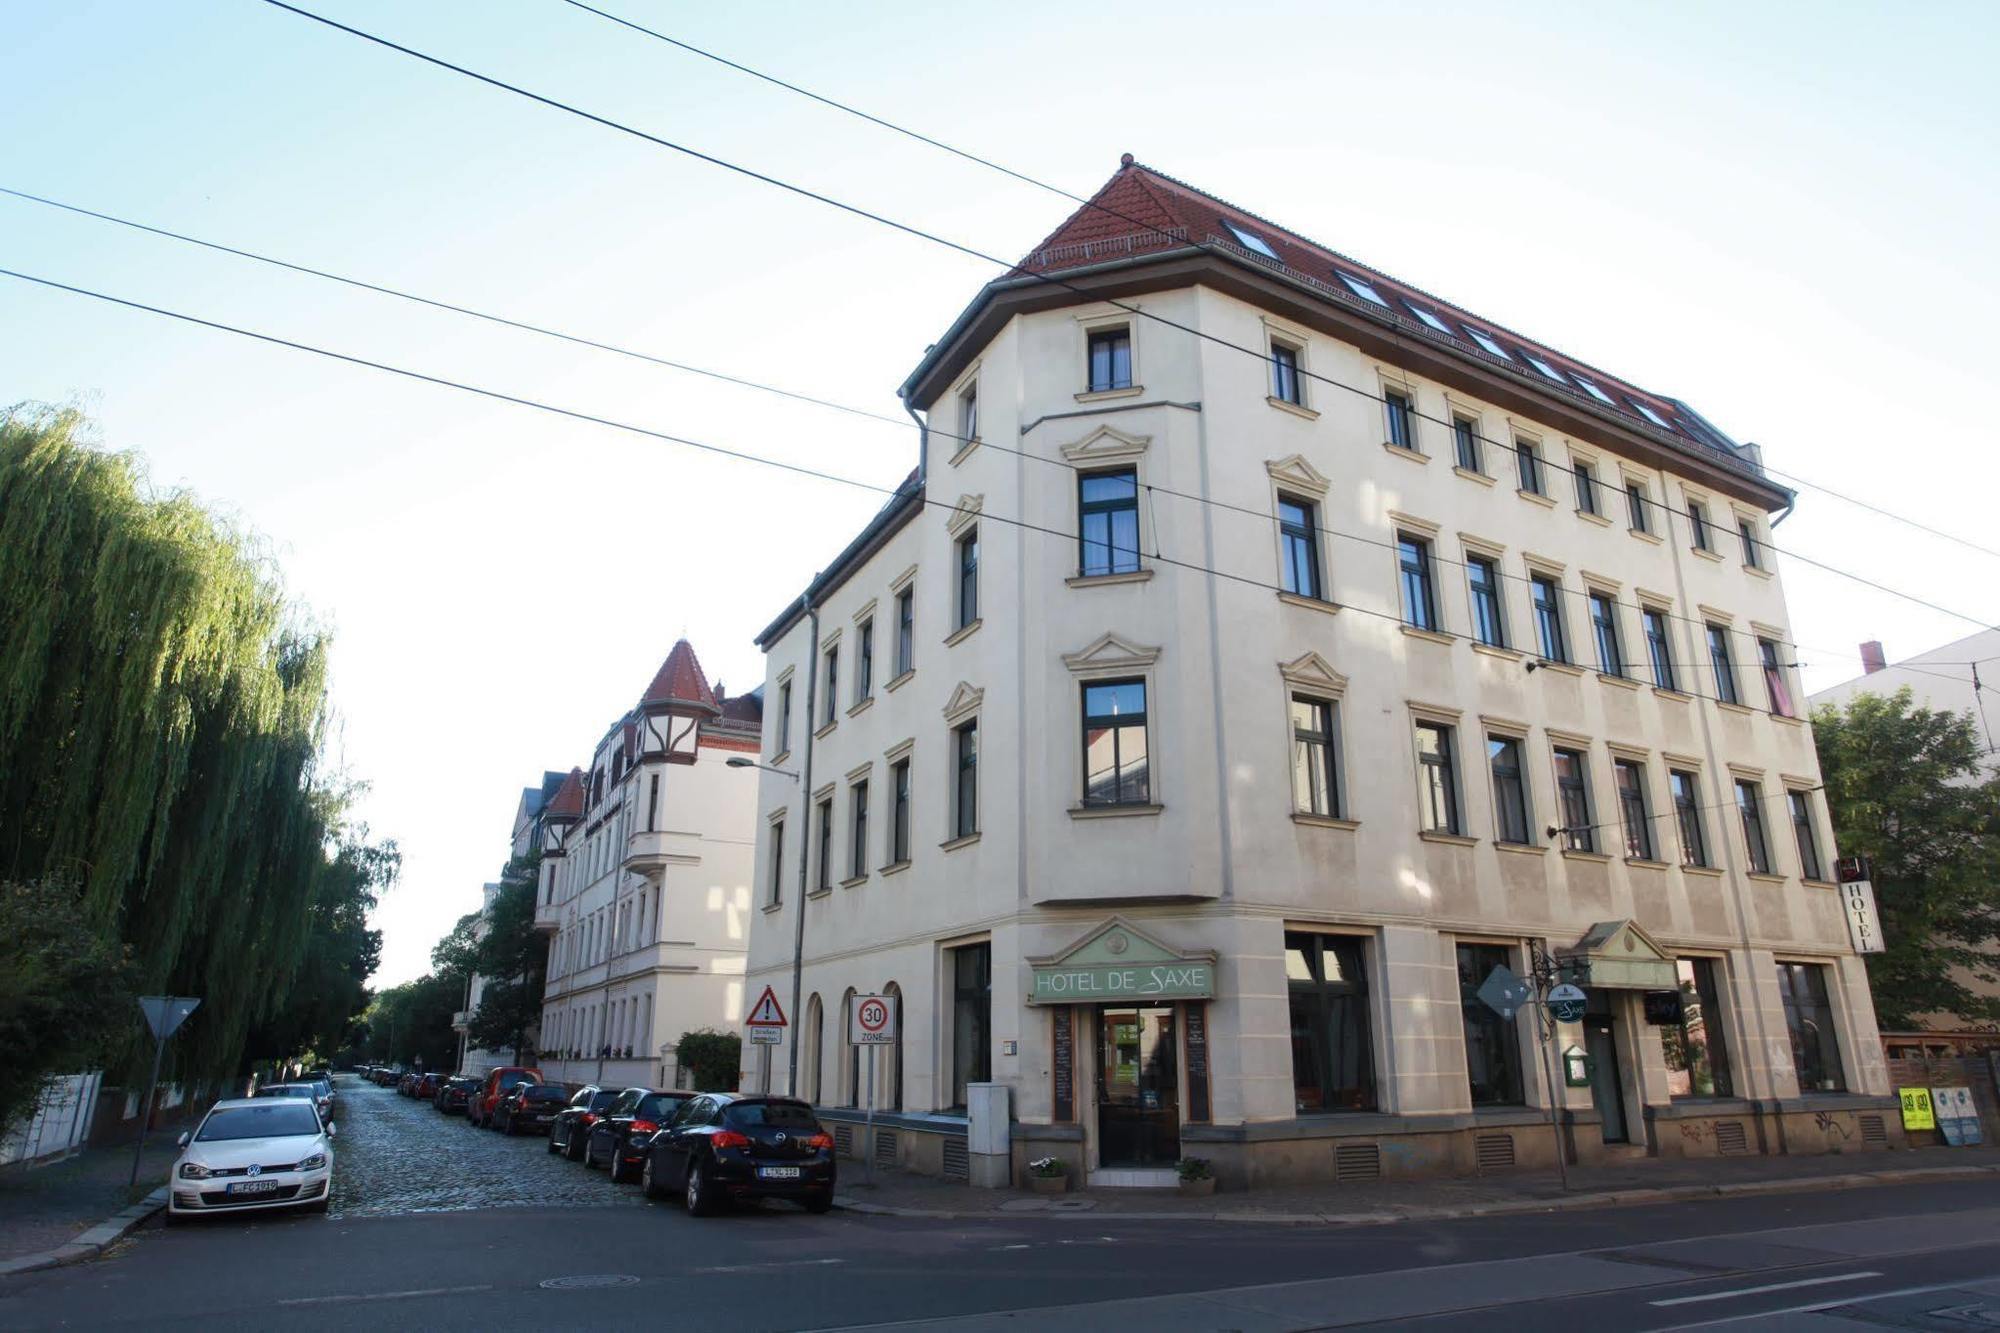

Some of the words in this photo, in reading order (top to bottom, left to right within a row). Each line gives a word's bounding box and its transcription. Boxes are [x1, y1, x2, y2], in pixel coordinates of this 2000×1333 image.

[1848, 884, 1874, 951] HOTEL
[1036, 973, 1104, 993] HOTEL
[1108, 971, 1137, 990] DE
[1139, 966, 1205, 994] SAXE
[865, 1008, 882, 1022] 30
[862, 1032, 884, 1041] ZONE
